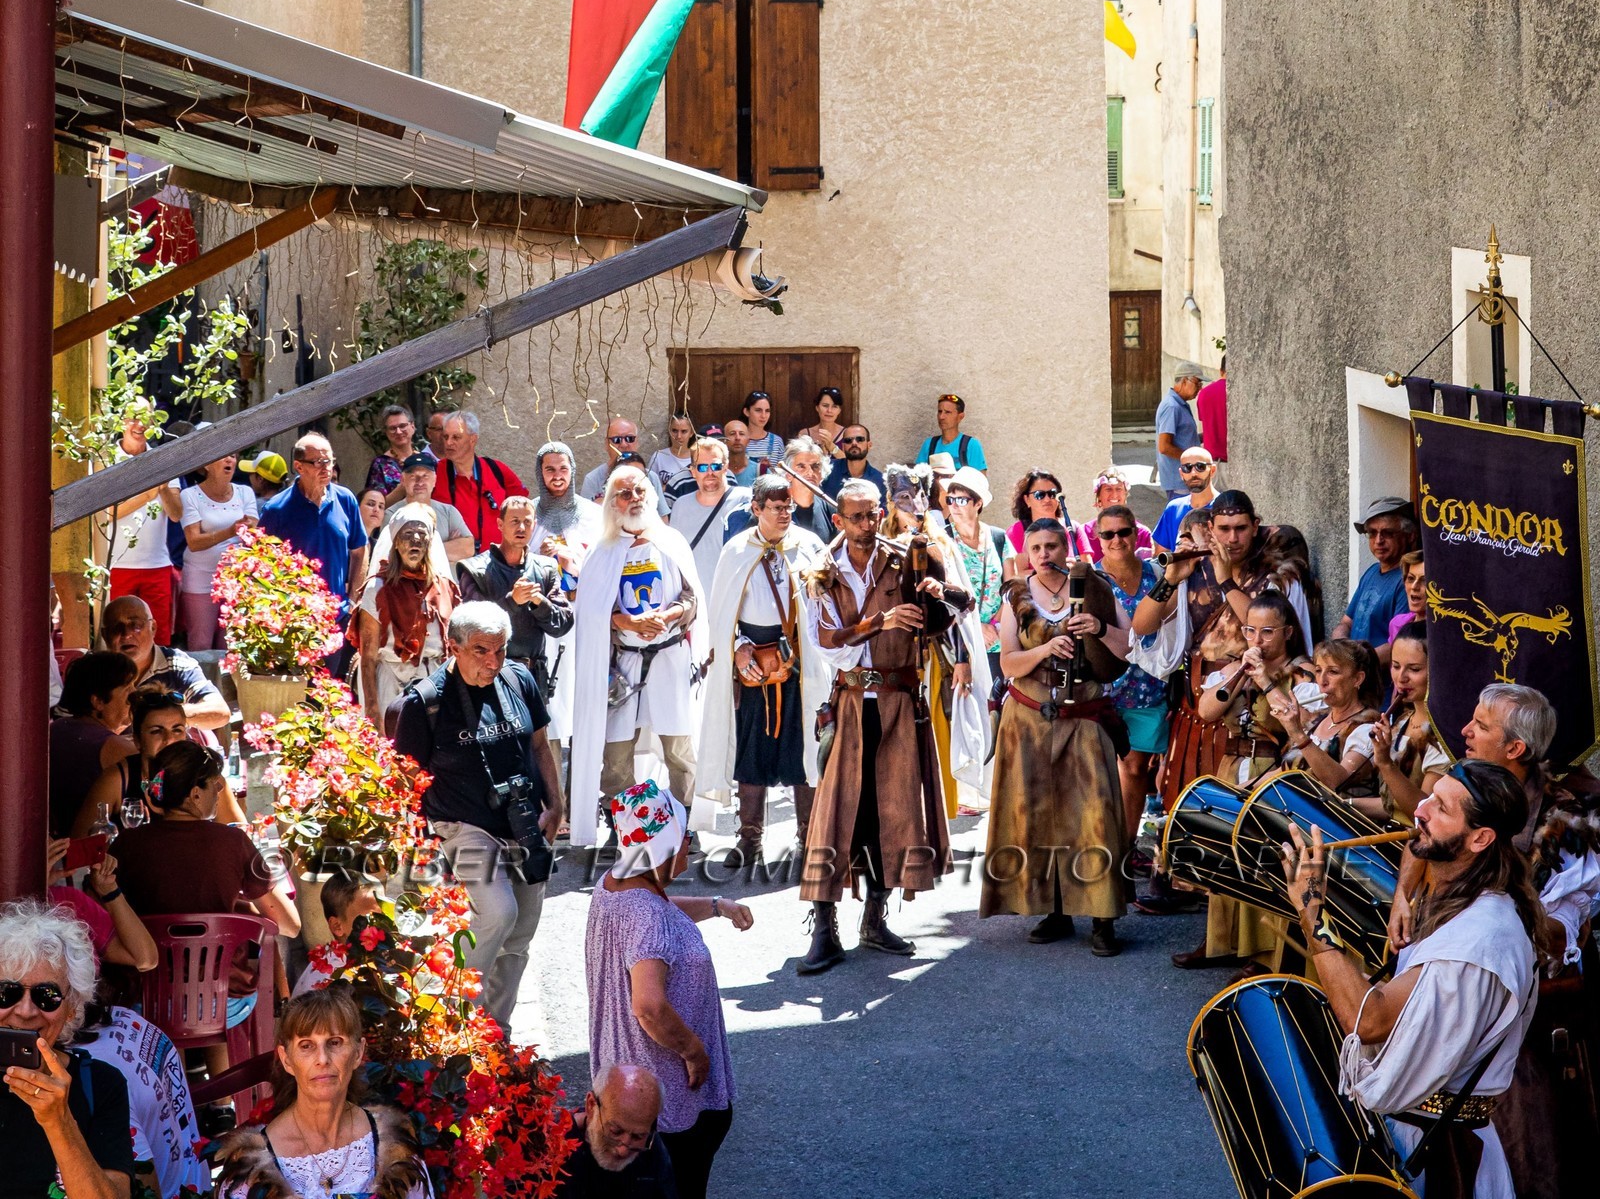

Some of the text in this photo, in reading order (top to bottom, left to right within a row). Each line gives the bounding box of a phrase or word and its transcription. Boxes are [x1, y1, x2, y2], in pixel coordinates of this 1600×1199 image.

[1419, 473, 1431, 495] le
[1421, 494, 1568, 557] CONDOR
[1440, 524, 1468, 546] Jean
